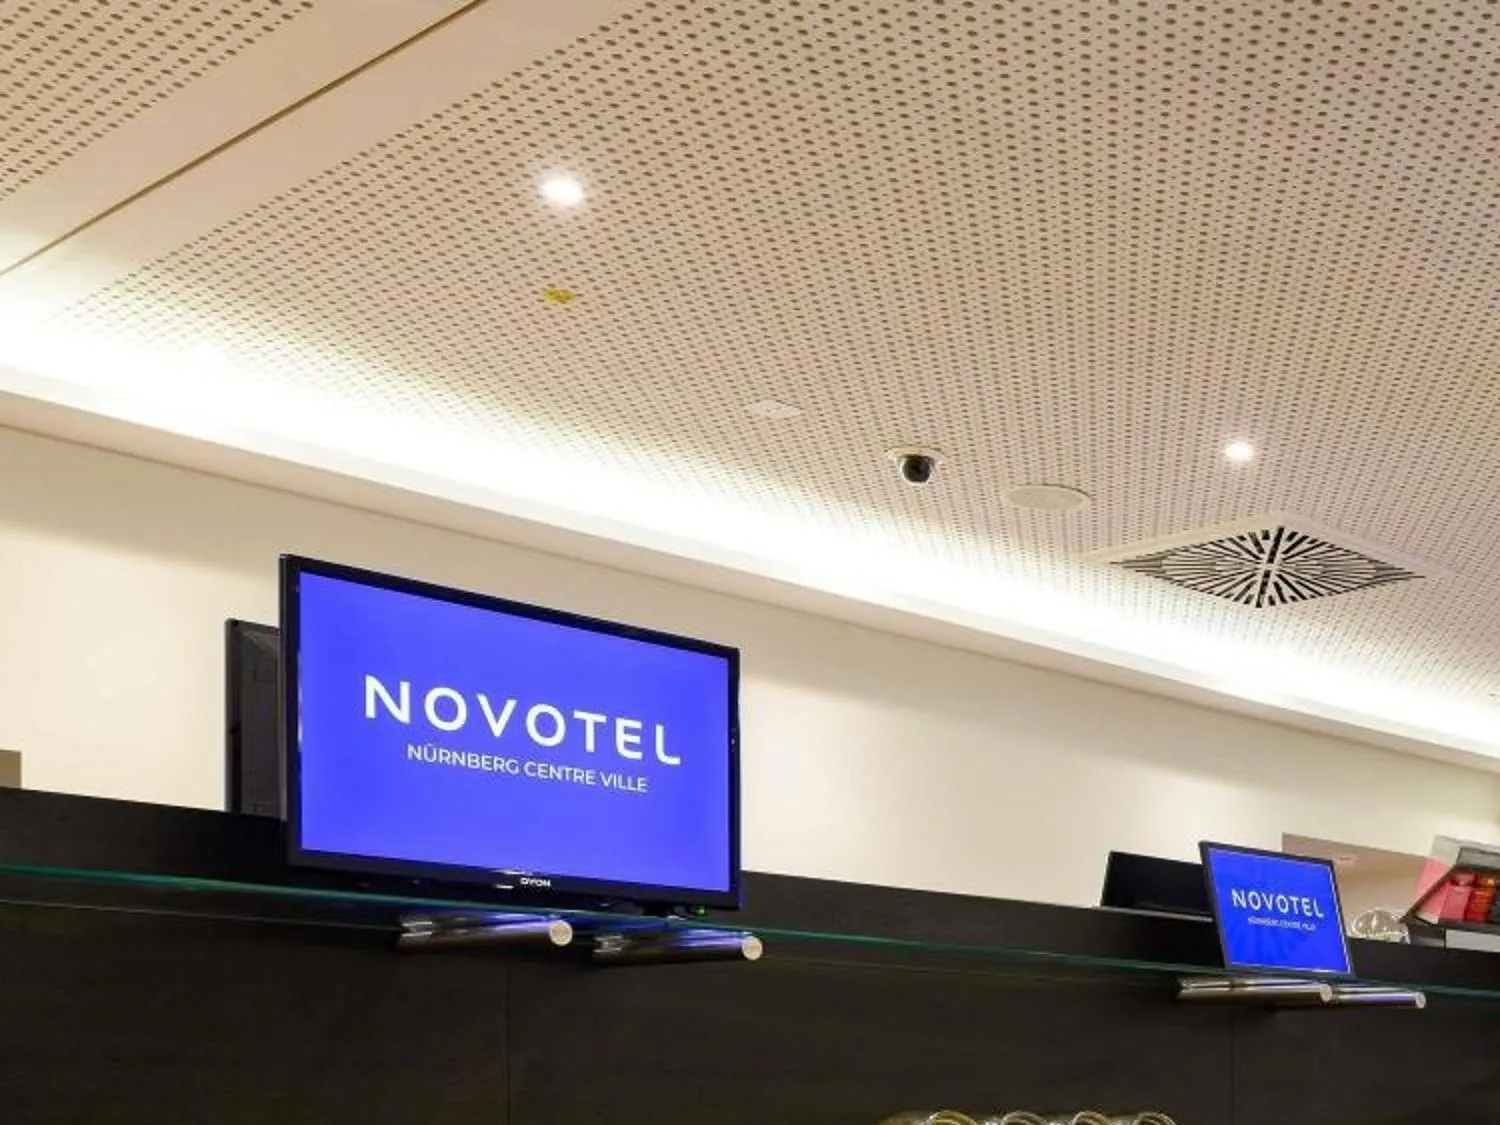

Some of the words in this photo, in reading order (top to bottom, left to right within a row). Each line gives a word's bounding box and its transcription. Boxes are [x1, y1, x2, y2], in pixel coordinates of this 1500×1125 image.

[364, 674, 681, 766] NOVOTEL
[407, 743, 519, 775] NÜRNBERG
[523, 761, 597, 786] CENTRE
[600, 772, 648, 793] VILLE
[1231, 888, 1325, 918] NOVOTEL
